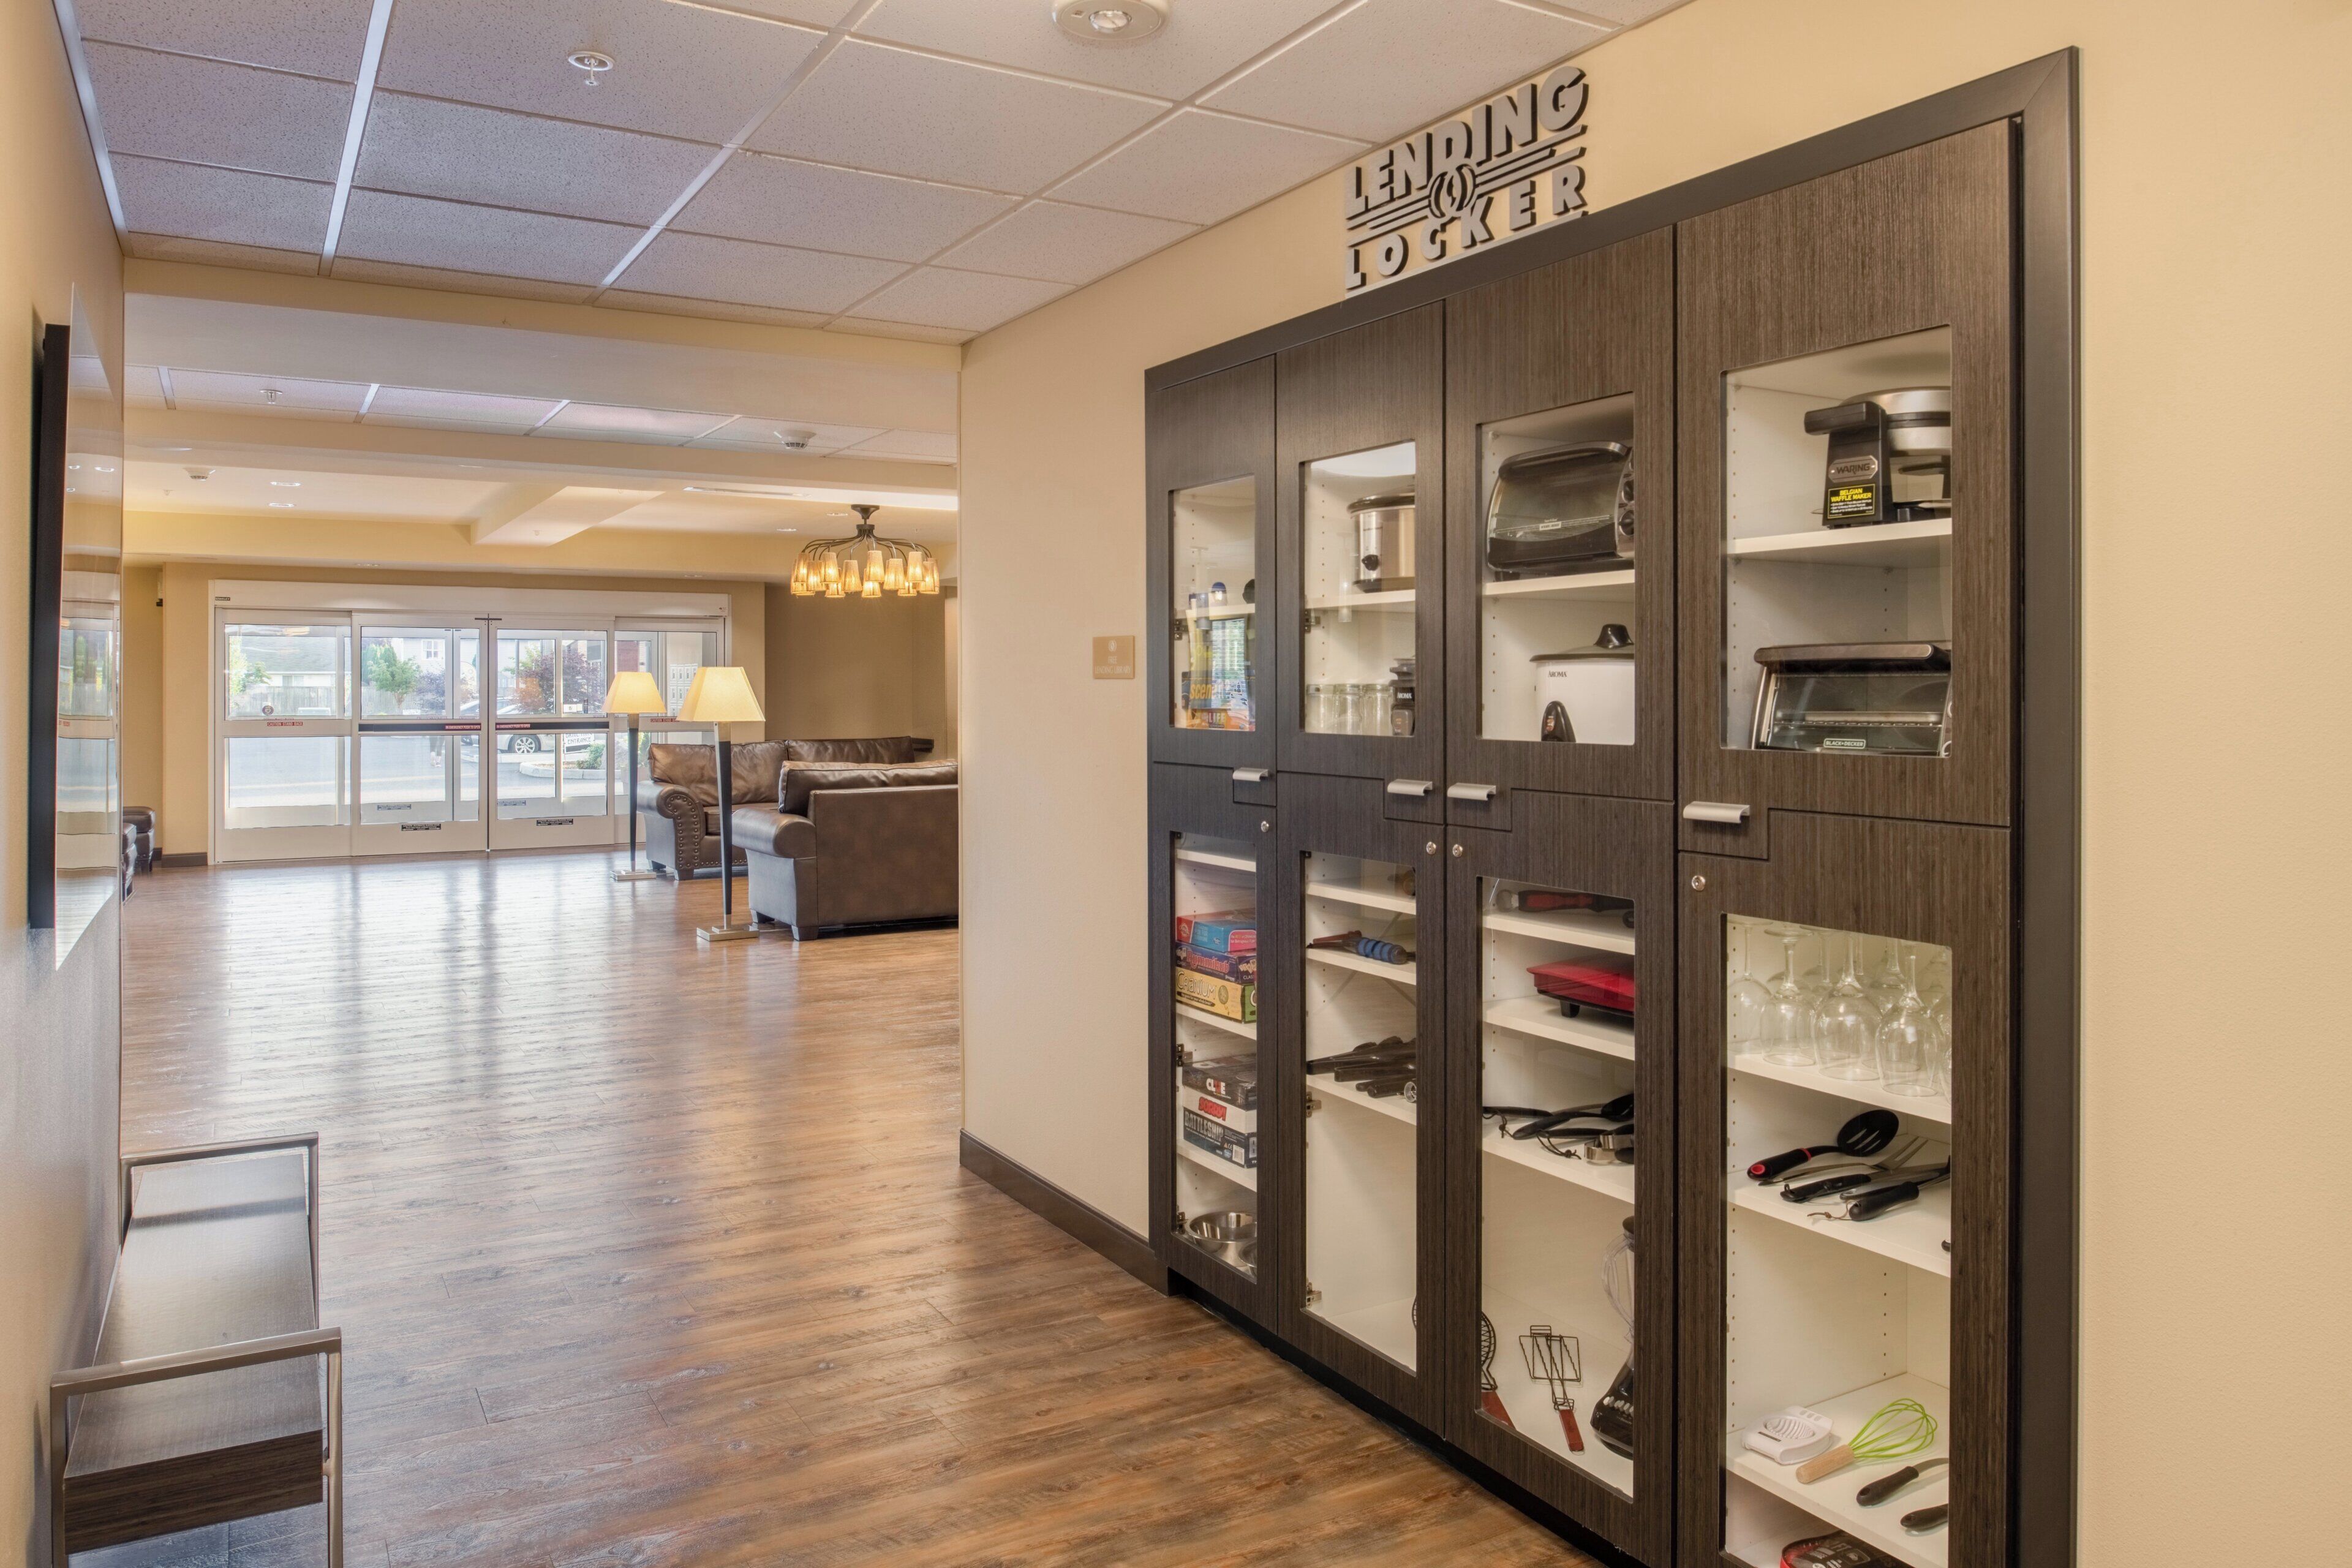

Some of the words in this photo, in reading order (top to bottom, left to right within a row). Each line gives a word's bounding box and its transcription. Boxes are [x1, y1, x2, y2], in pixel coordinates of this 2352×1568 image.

[1346, 66, 1589, 219] LENDING
[1346, 165, 1587, 290] LOCKER
[1836, 463, 1870, 475] WARING
[1186, 949, 1229, 974] Rummikub
[1206, 1078, 1226, 1095] CLUE
[1198, 1096, 1227, 1121] SORRY!
[1185, 1110, 1224, 1142] BATTLESHIP
